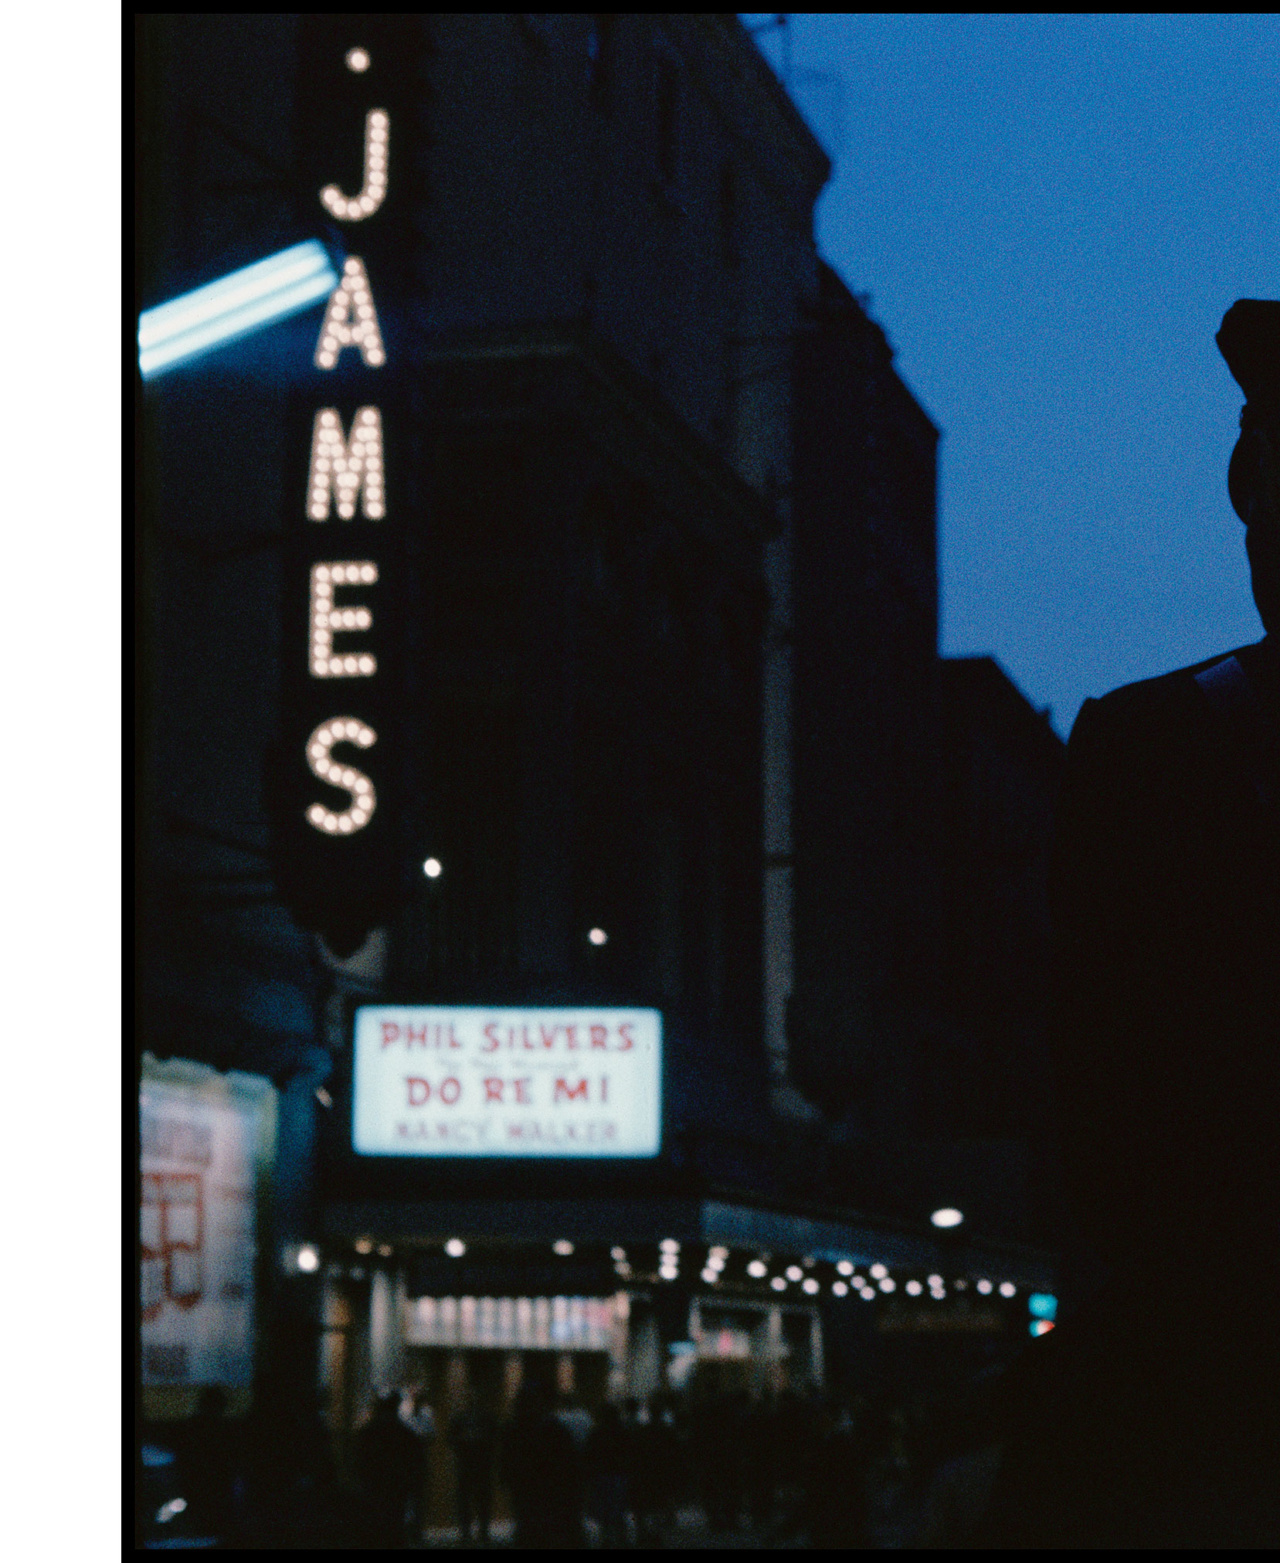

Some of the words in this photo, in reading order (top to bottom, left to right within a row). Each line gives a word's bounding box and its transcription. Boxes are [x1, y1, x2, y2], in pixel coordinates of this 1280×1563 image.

[305, 107, 388, 837] JAMES
[379, 1020, 462, 1051] PHIL
[481, 1021, 637, 1053] SILVERS
[404, 1075, 464, 1108] DO
[481, 1076, 534, 1106] RE
[553, 1075, 610, 1107] MI
